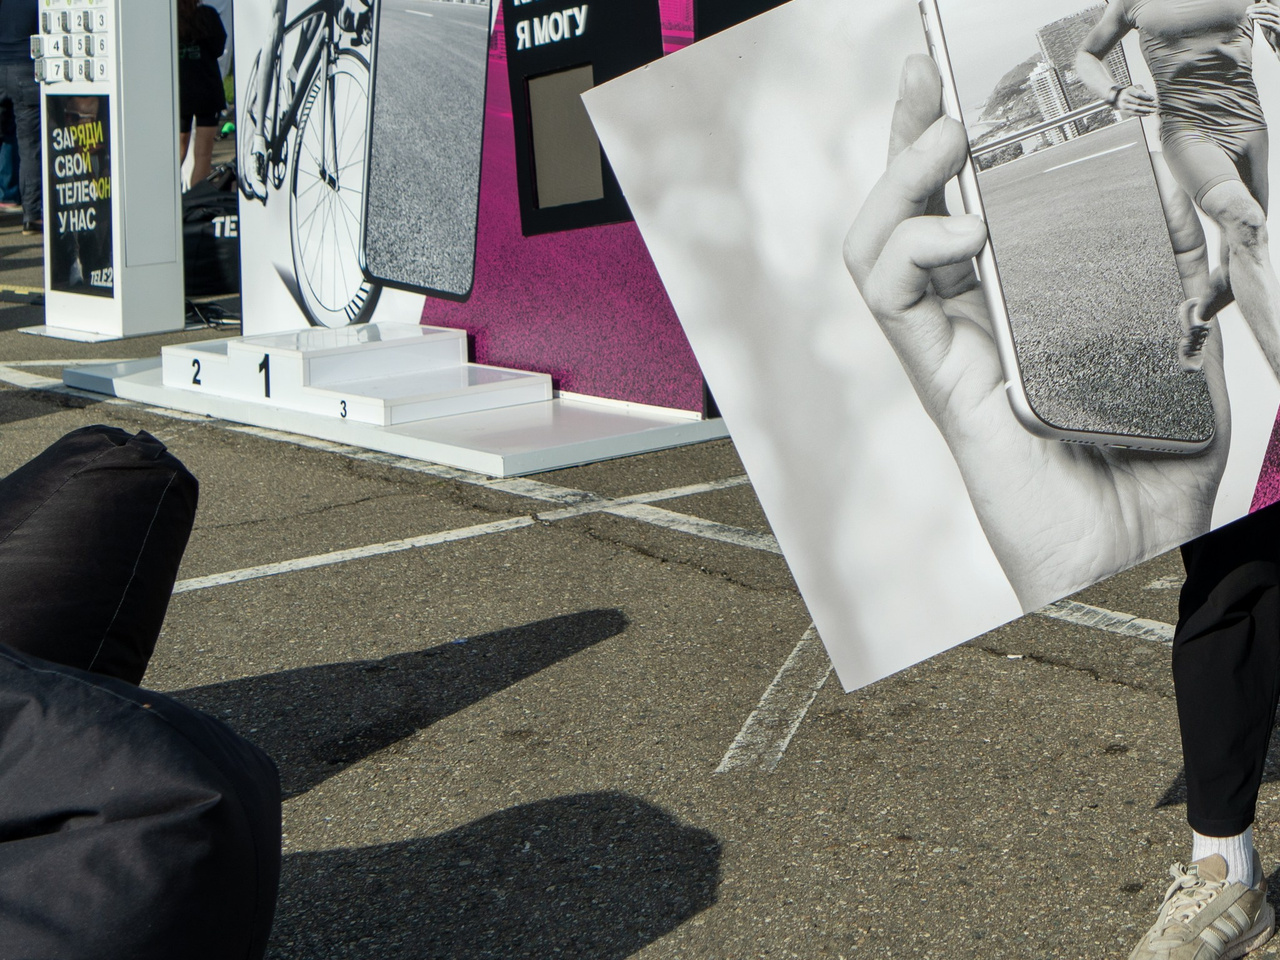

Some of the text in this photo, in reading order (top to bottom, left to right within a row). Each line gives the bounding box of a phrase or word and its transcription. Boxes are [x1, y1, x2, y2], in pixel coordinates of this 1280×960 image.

[76, 15, 82, 27] 2
[99, 14, 105, 26] 3
[516, 4, 589, 51] Я МОГУ
[53, 39, 105, 52] 4 5 6
[54, 63, 105, 76] 7 8 9
[52, 121, 104, 151] ЗАРЯДИ
[55, 146, 92, 178] СВОЙ
[56, 176, 111, 205] ТЕЛЕФОН
[58, 207, 97, 233] У НАС
[212, 215, 238, 238] TE
[90, 268, 113, 287] TELE2
[192, 358, 201, 385] 2
[258, 353, 271, 398] 1
[340, 400, 347, 418] 3
